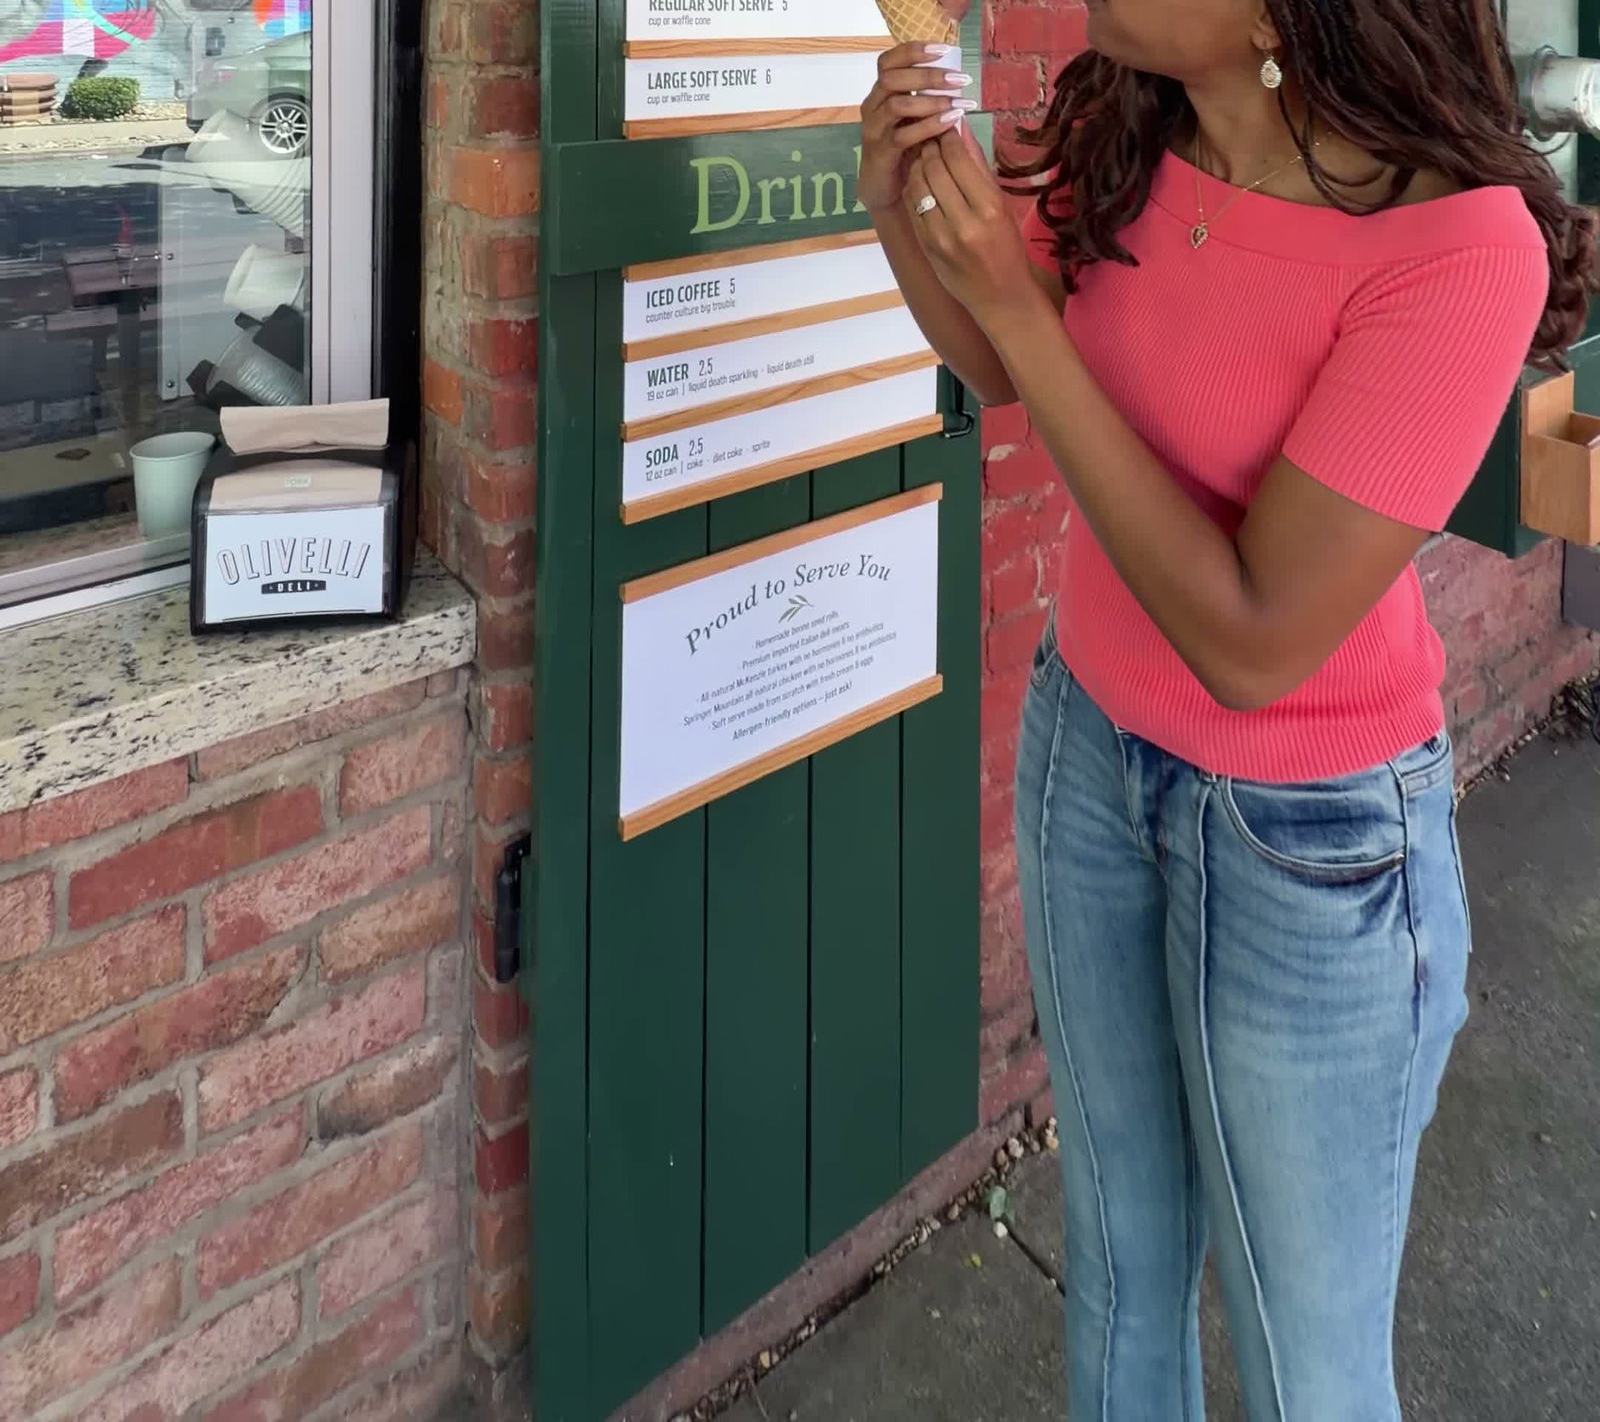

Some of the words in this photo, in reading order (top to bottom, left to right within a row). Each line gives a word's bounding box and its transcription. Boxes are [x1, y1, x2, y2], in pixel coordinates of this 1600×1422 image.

[648, 17, 661, 27] cup
[662, 17, 671, 25] or
[671, 15, 693, 25] waffle
[694, 16, 711, 25] cone
[648, 71, 687, 90] LARGE
[690, 70, 719, 89] SOFT
[722, 69, 757, 86] SERVE
[765, 68, 771, 85] 6
[647, 95, 660, 105] cup
[661, 95, 670, 104] or
[670, 92, 692, 103] waffle
[693, 93, 710, 102] cone
[646, 288, 674, 309] ICED
[677, 280, 720, 303] COFFEE
[730, 278, 735, 294] 5
[645, 309, 673, 323] counter
[674, 304, 699, 319] culture
[700, 302, 711, 314] big
[712, 297, 735, 312] trouble
[646, 391, 655, 401] 19
[656, 390, 664, 400] oz
[665, 387, 678, 397] can
[688, 379, 707, 393] liquid
[708, 375, 728, 388] death
[728, 368, 758, 384] sparkling
[766, 361, 784, 375] liquid
[784, 357, 802, 371] death
[647, 363, 689, 388] WATER
[698, 357, 713, 377] 2.5
[645, 443, 679, 468] SODA
[689, 437, 703, 457] 2.5
[645, 470, 653, 481] 12
[654, 469, 662, 479] oz
[663, 466, 677, 477] can
[687, 458, 703, 470] coke
[713, 451, 726, 464] diet
[727, 446, 743, 459] coke
[752, 440, 770, 453] sprite
[217, 537, 371, 586] OLIVELLI
[277, 581, 311, 592] DELI
[684, 584, 758, 657] Proud
[765, 579, 785, 599] to
[793, 562, 850, 588] Serve
[857, 554, 891, 581] You
[711, 681, 735, 697] natural
[792, 698, 817, 715] options
[824, 687, 838, 702] just
[712, 717, 726, 730] Soft
